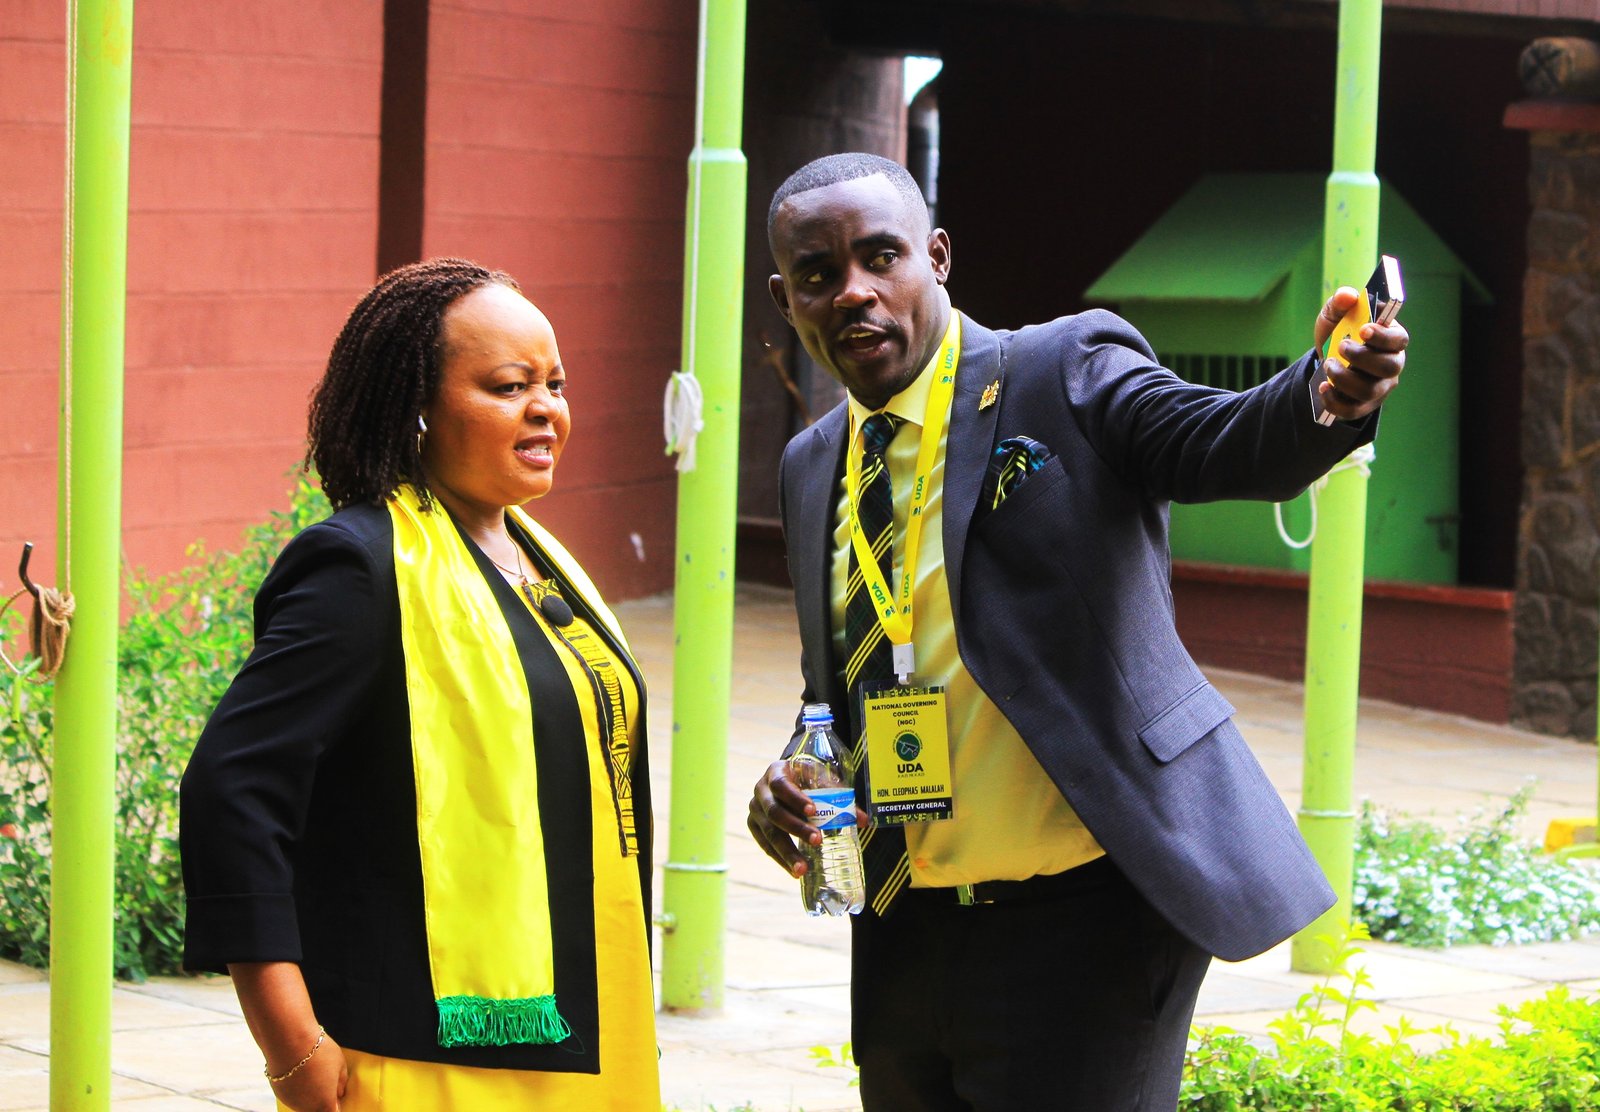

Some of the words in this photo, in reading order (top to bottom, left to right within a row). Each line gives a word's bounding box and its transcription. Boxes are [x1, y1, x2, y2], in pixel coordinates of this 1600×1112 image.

[945, 347, 954, 369] UDA
[915, 475, 924, 500] UDA
[872, 581, 886, 605] UDA
[871, 703, 902, 711] NATIONAL
[902, 700, 938, 708] GOVERNING
[897, 718, 916, 727] (NGC)
[897, 762, 924, 773] UDA
[877, 788, 890, 797] HON.
[892, 786, 918, 796] CLEOPHAS
[920, 784, 944, 794] MALALAH
[815, 806, 834, 816] sani
[877, 803, 915, 812] SECRETARY
[916, 801, 947, 809] GENERAL
